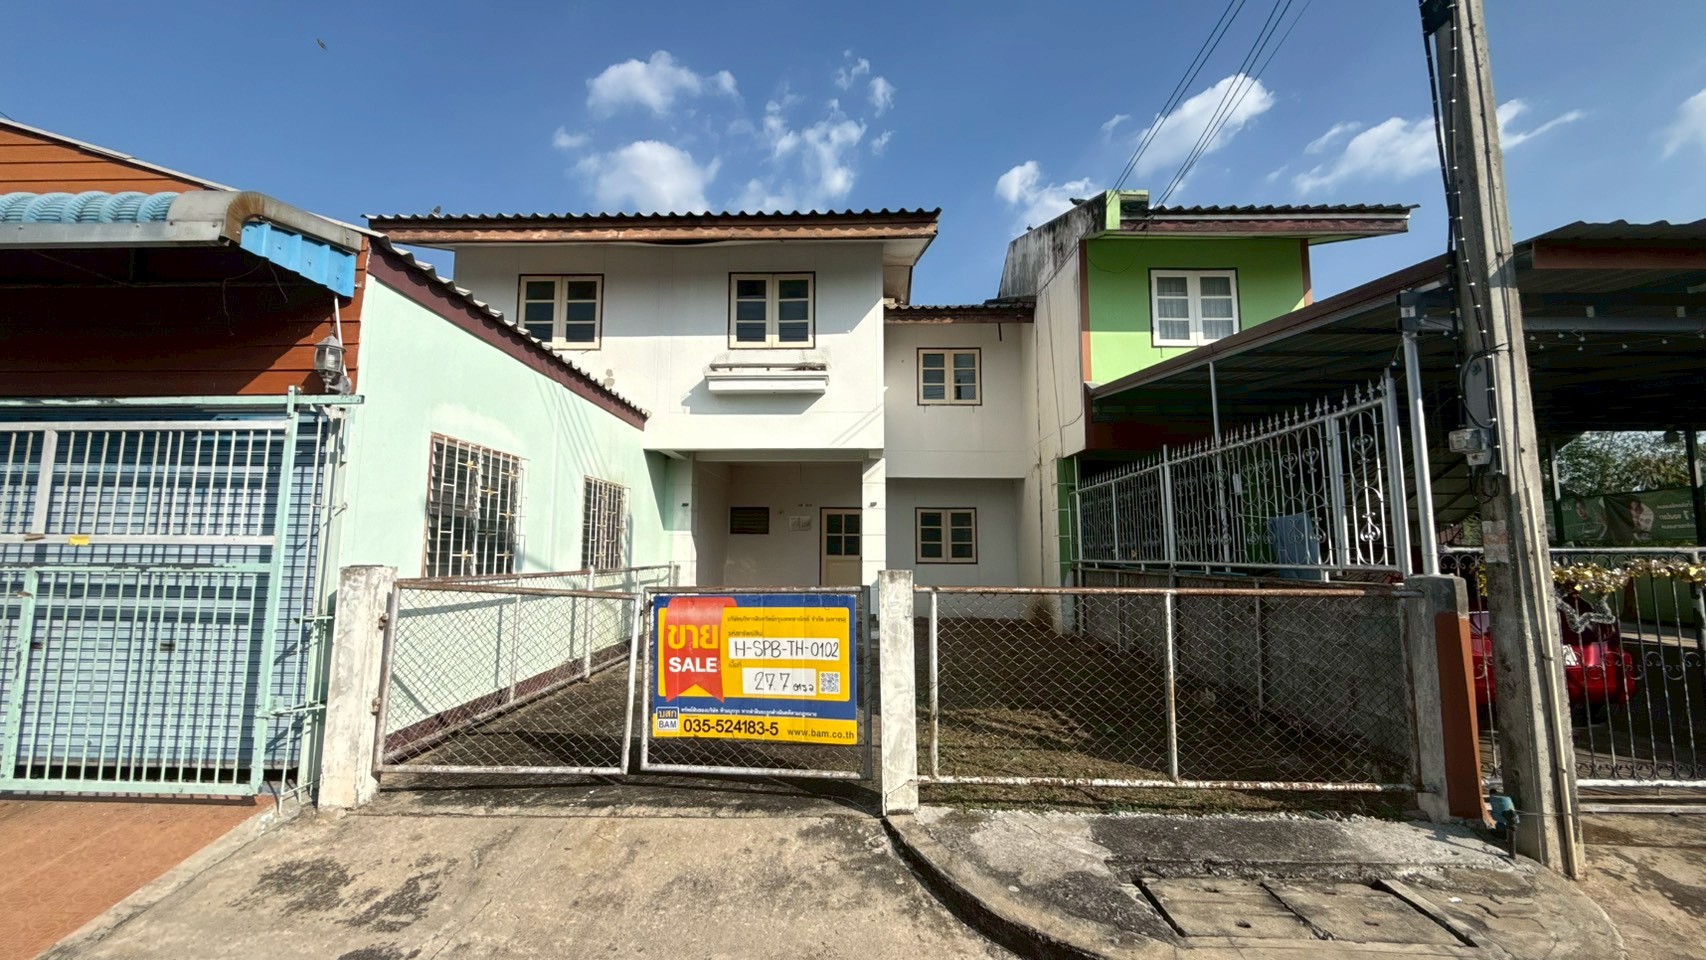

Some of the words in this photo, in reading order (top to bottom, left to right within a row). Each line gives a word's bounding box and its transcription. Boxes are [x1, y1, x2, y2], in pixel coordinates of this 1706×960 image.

[667, 624, 719, 649] ขาย
[734, 640, 839, 659] H-SPB-TH-0102
[668, 657, 718, 673] SALE
[658, 709, 677, 718] บสก
[658, 720, 677, 729] BAM
[683, 719, 779, 736] 035-524183-5
[787, 727, 855, 740] www.bam.co.th
